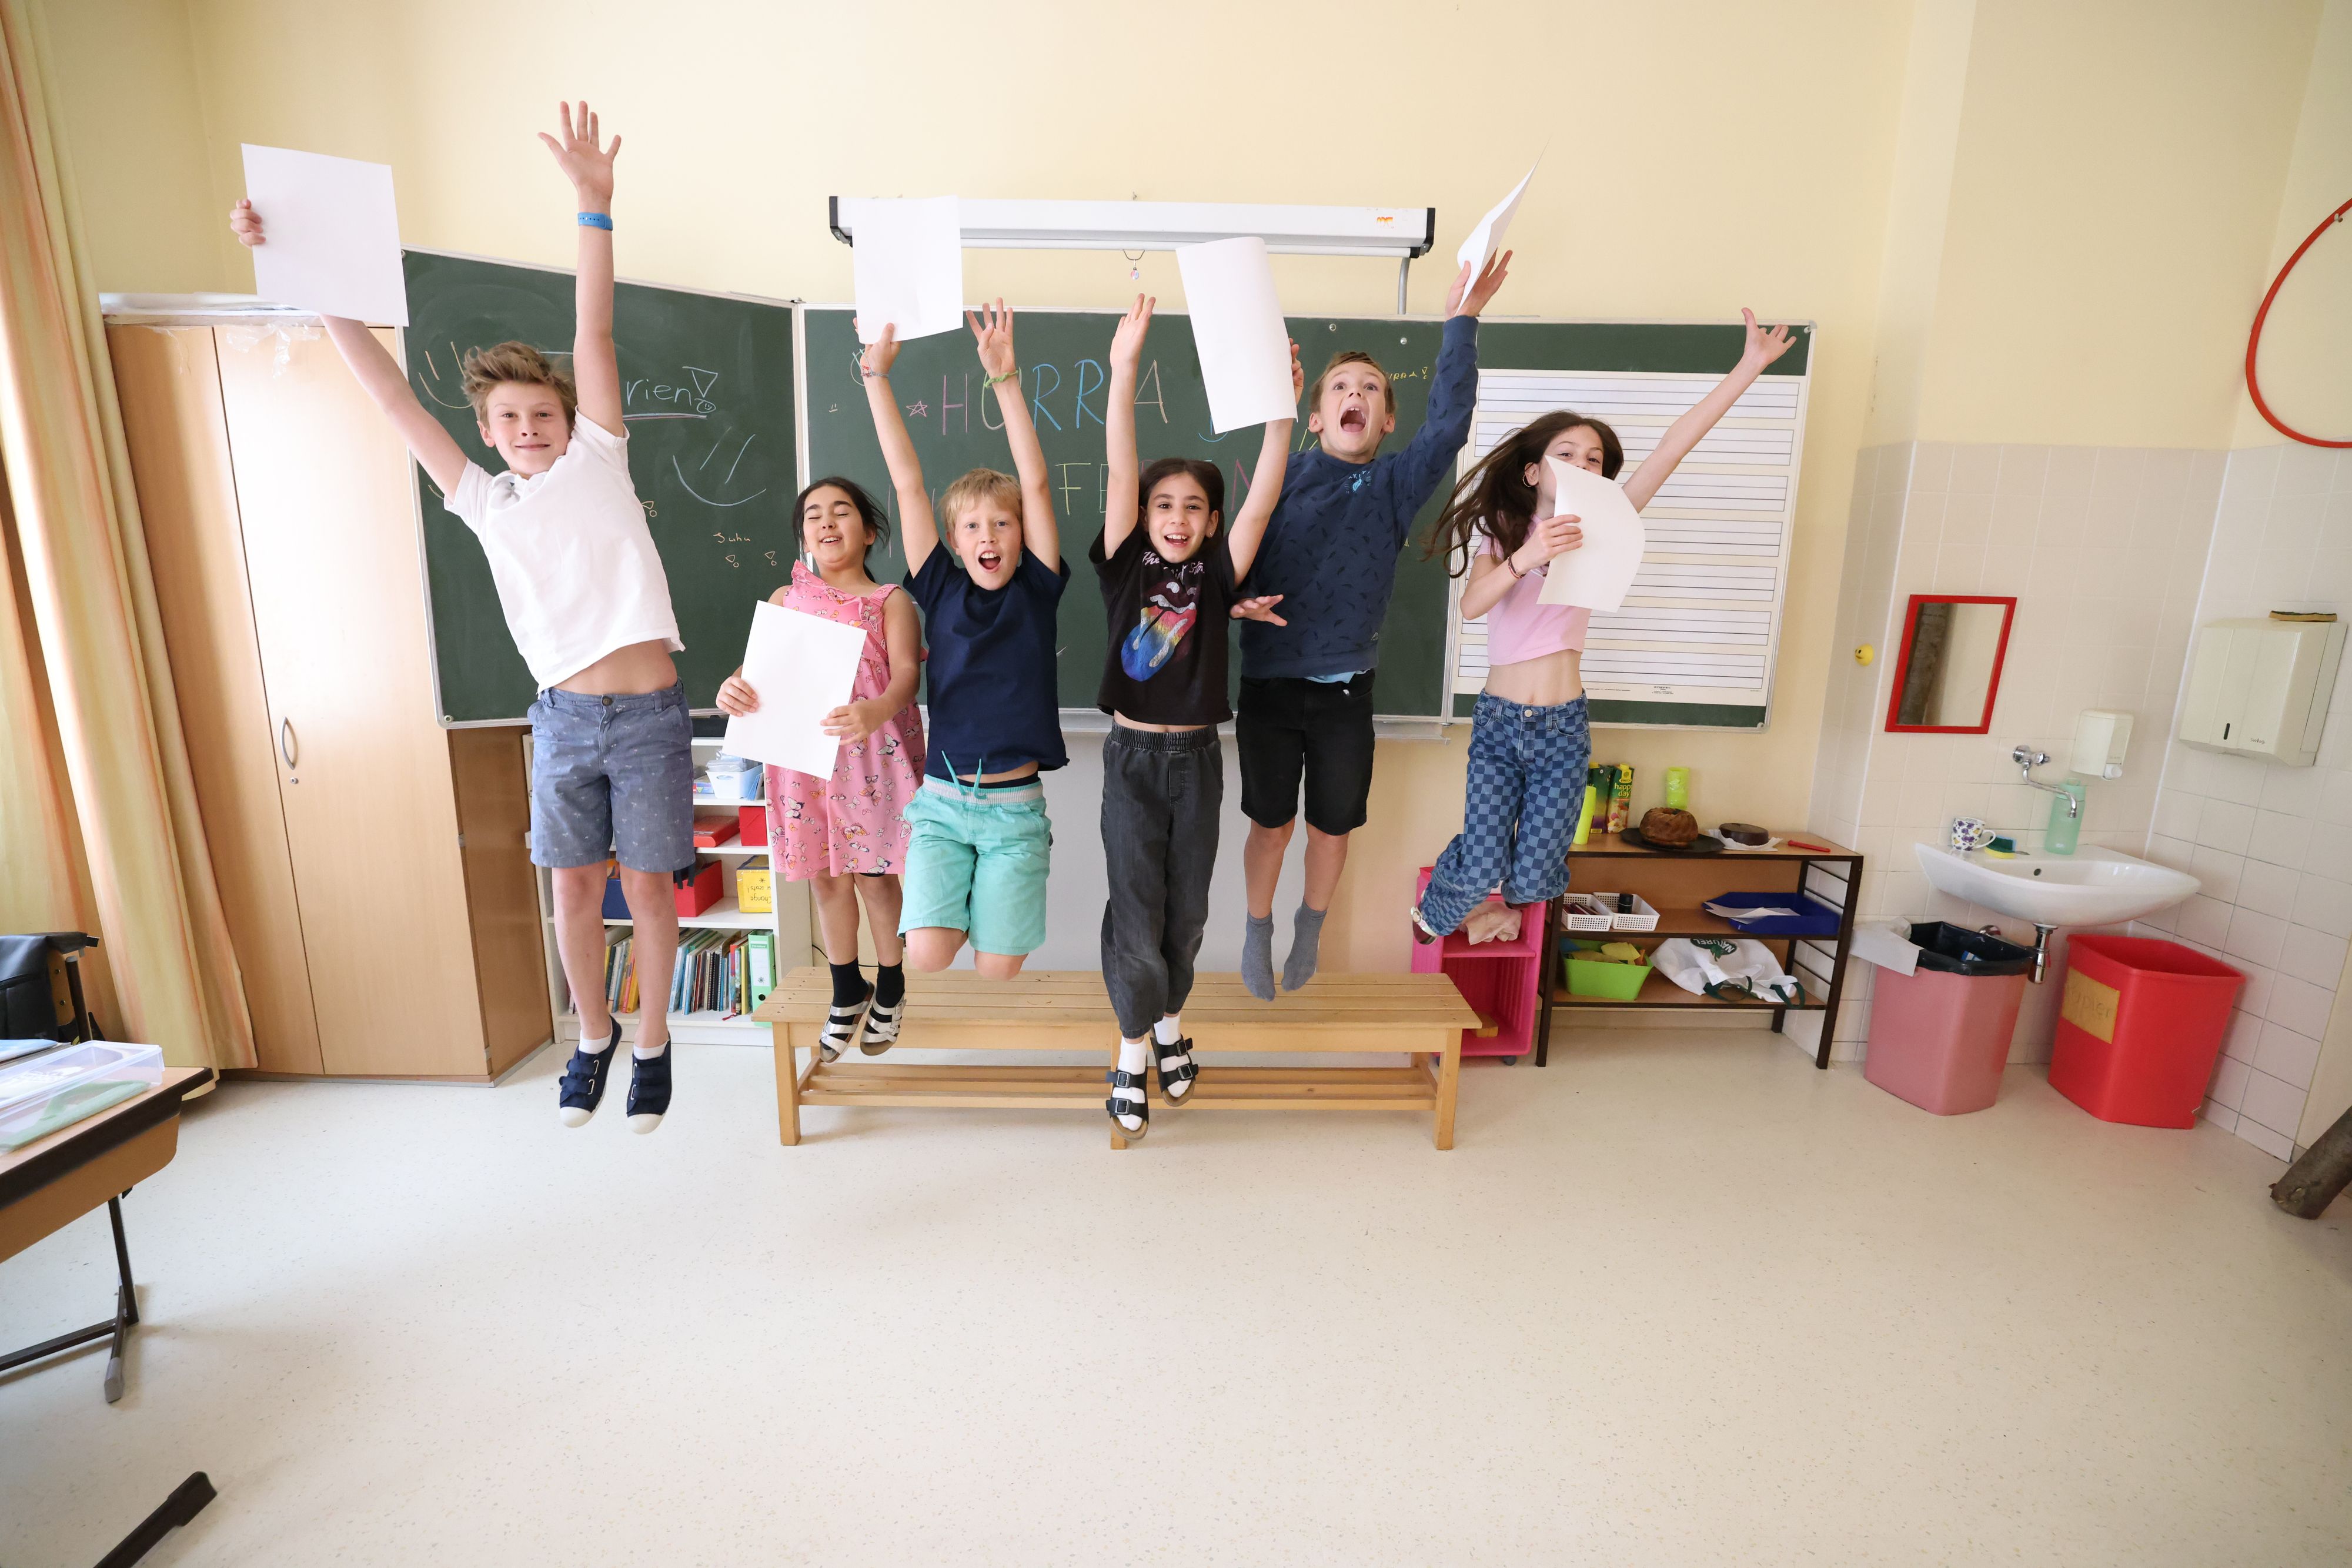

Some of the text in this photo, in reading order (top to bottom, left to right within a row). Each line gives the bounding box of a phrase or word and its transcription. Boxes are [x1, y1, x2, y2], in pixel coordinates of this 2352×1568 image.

[943, 359, 1168, 436] HURRA
[1142, 551, 1160, 566] The
[1614, 783, 1632, 791] happ
[1618, 790, 1631, 798] day
